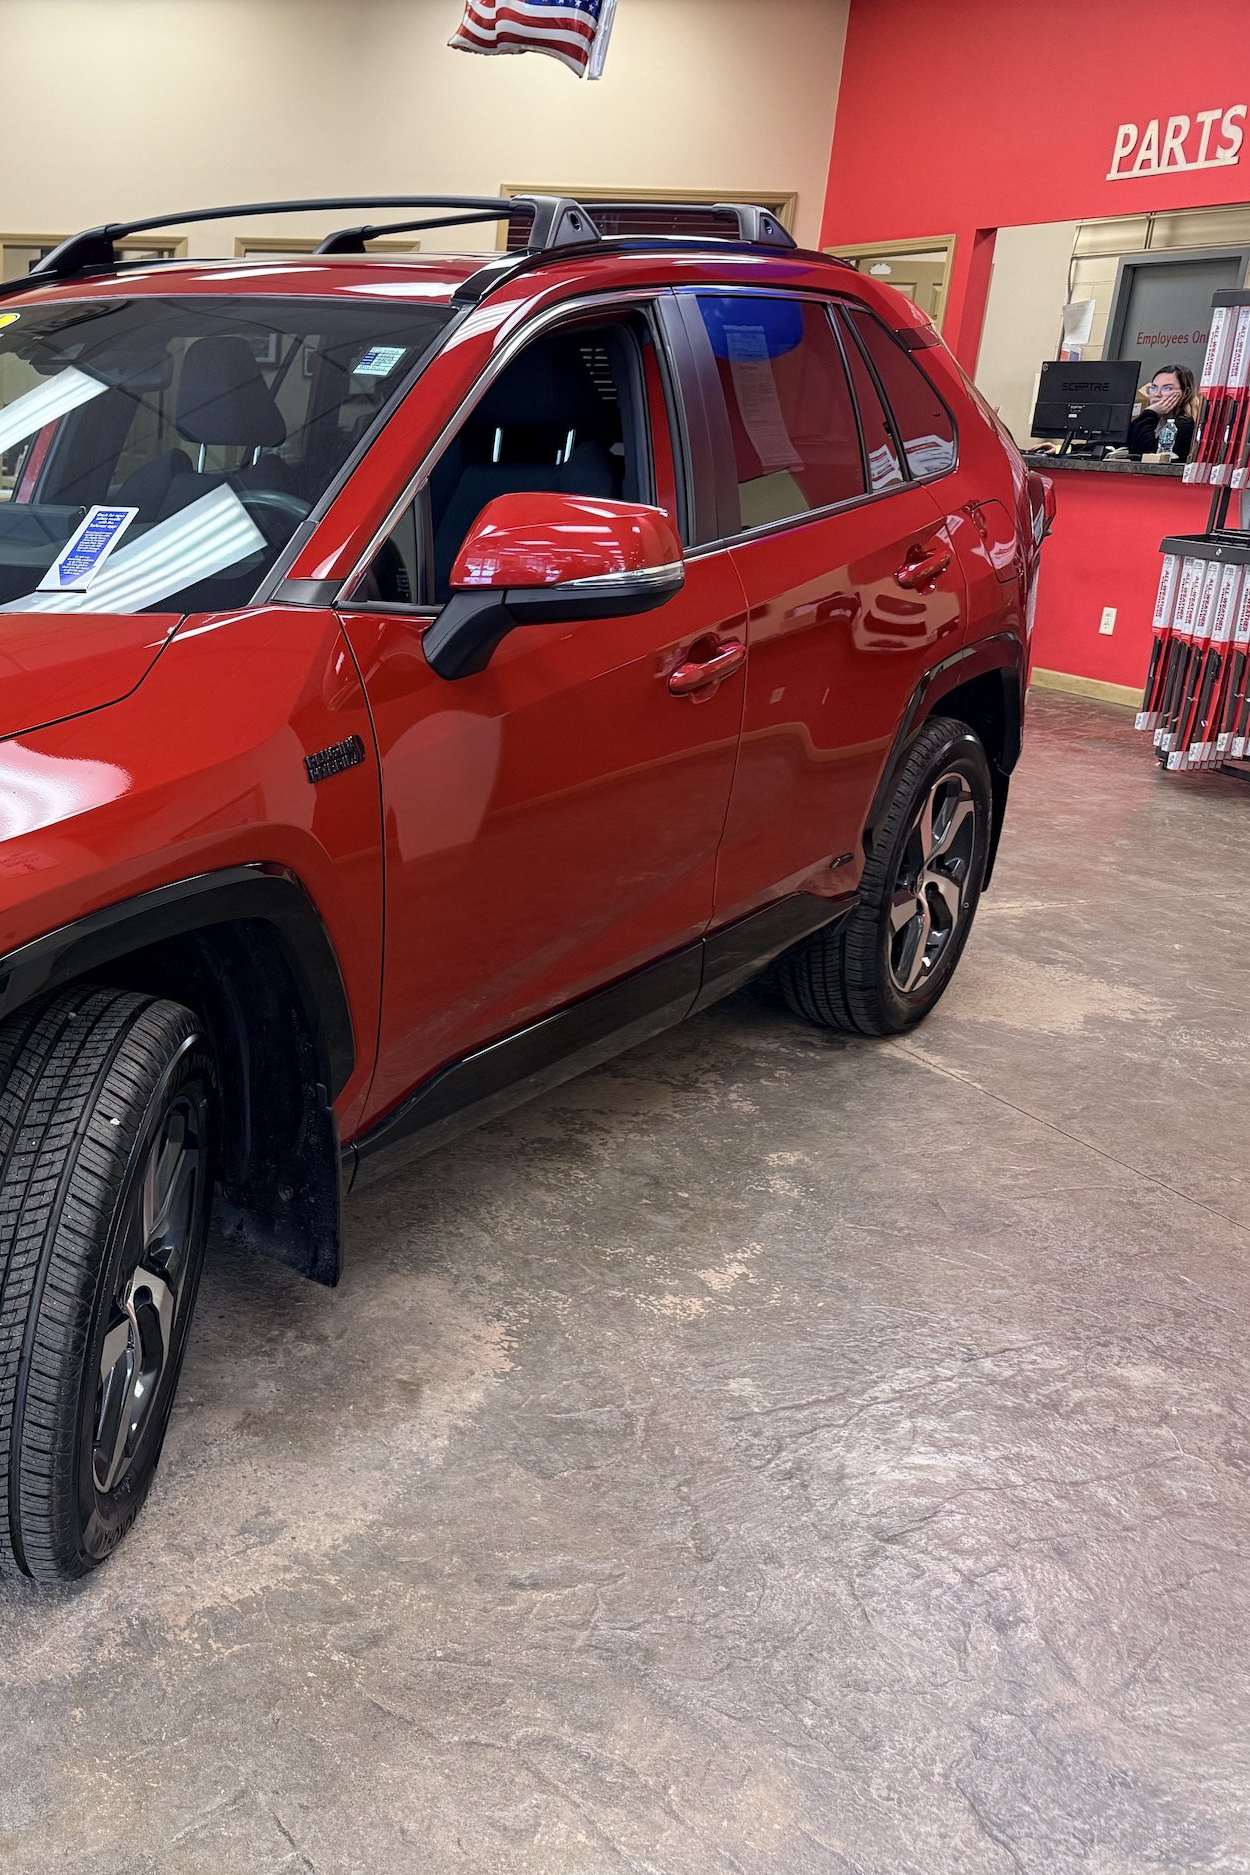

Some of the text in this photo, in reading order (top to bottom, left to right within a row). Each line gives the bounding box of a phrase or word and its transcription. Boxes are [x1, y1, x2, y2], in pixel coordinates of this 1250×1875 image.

[1108, 104, 1248, 177] PARTS
[1137, 331, 1189, 348] Employees
[1062, 382, 1110, 391] SCEPTRE
